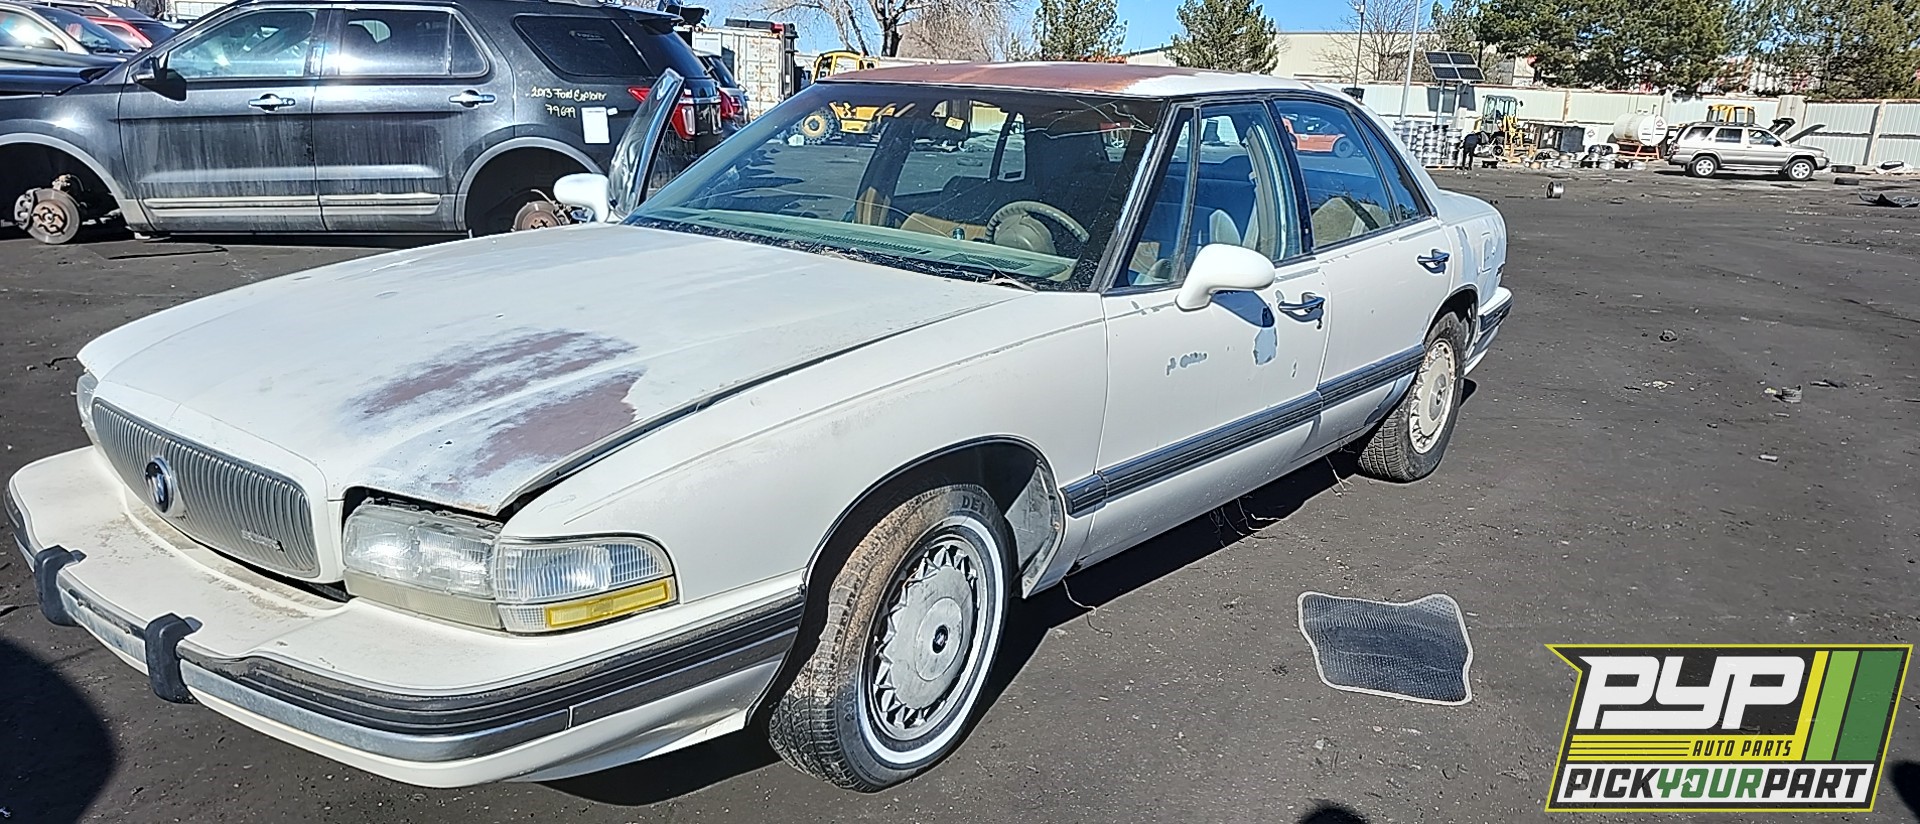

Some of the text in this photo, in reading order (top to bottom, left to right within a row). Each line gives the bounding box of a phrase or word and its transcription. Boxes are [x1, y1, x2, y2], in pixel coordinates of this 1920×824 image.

[531, 86, 607, 102] 2013 Ford Explorer
[545, 103, 576, 118] 79699
